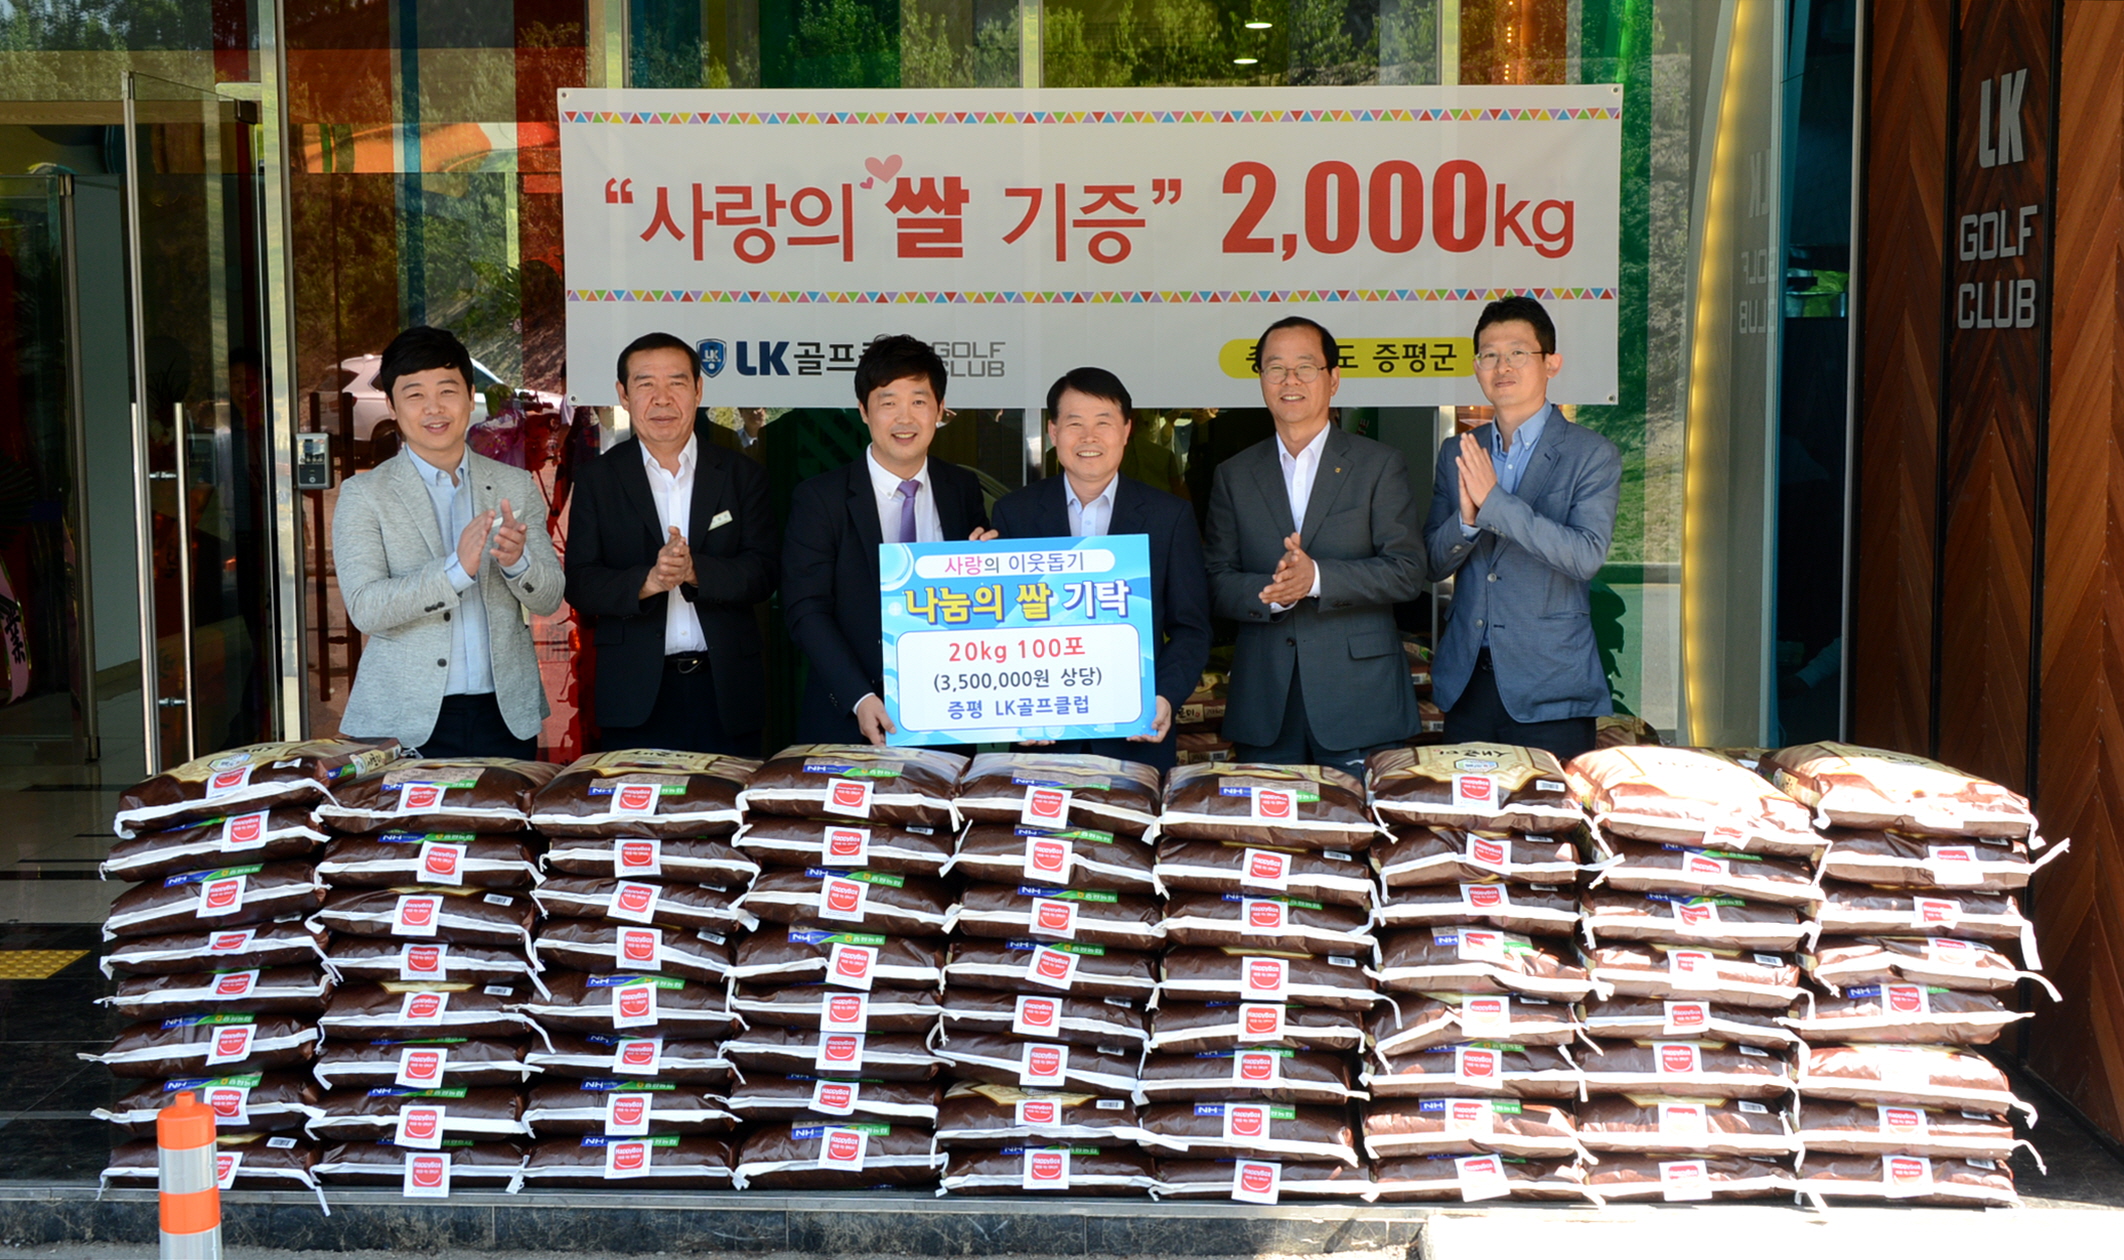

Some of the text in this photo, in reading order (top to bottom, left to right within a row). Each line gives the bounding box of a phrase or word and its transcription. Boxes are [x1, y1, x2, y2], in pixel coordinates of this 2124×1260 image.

[1979, 68, 2028, 169] LK
[885, 176, 970, 258] 쌀
[1222, 159, 1574, 261] 2,000kg
[1959, 204, 2038, 262] GOLF
[1957, 278, 2036, 329] CLUB
[736, 341, 868, 376] LK골프
[932, 342, 1006, 358] GOLF
[1373, 343, 1457, 373] 증평군
[945, 552, 1084, 575] 사랑의 이웃돕기
[904, 579, 1131, 624] 나눔의 쌀 기탁
[949, 636, 1086, 663] 20kg 100포
[933, 666, 1103, 693] (3,500,000원 상당)
[947, 695, 1089, 720] 증평 LK골프클럽
[168, 876, 187, 885] NH
[1022, 886, 1040, 894] NH
[792, 934, 810, 942] NH
[168, 1081, 187, 1089] NH
[795, 1129, 814, 1137] NH
